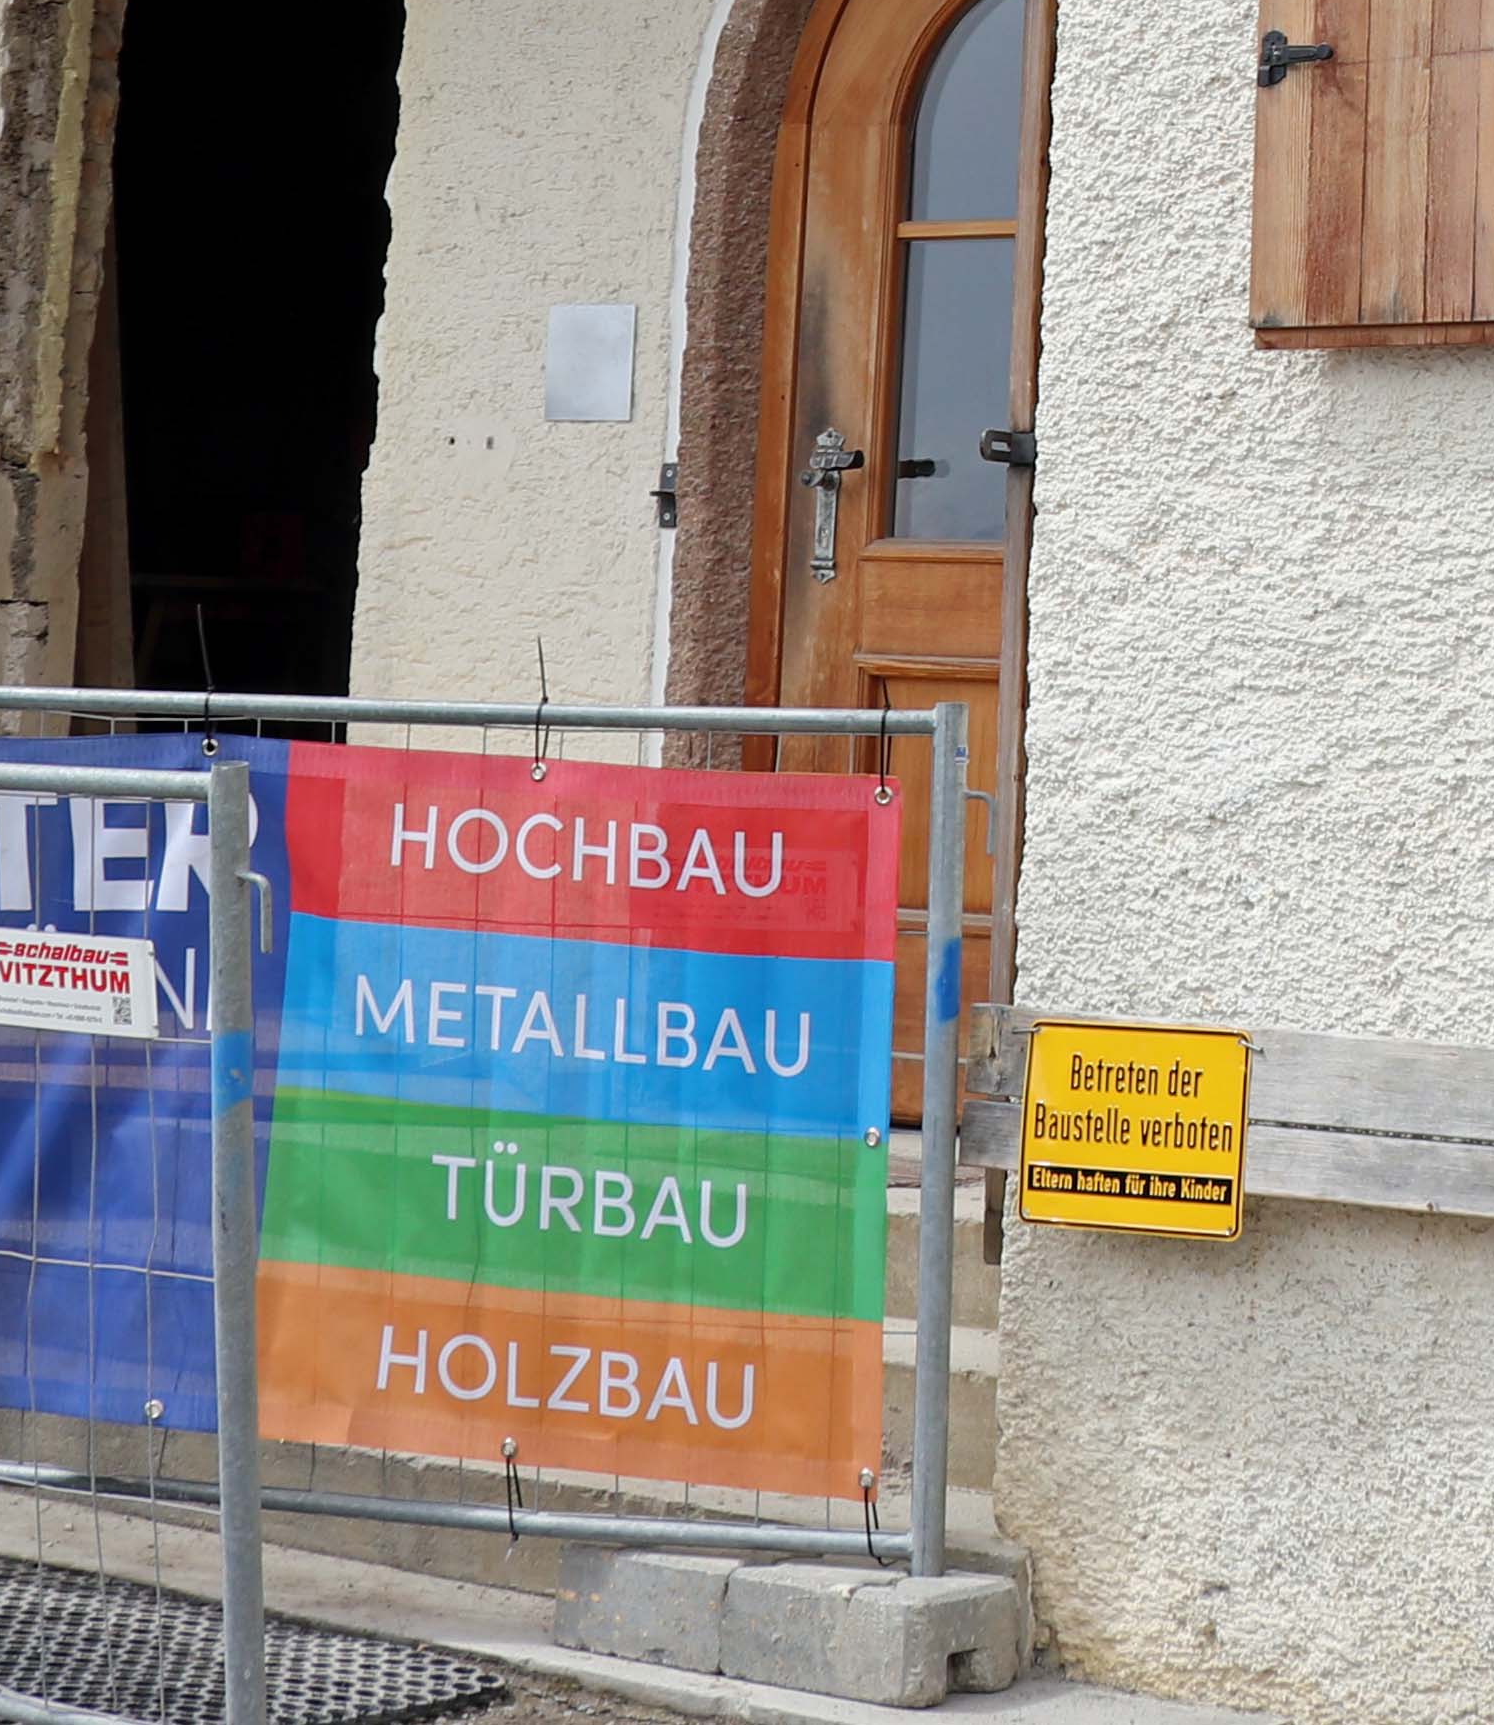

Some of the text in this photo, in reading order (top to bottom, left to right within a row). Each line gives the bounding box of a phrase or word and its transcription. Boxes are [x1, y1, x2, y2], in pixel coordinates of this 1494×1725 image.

[390, 802, 784, 897] HOCHBAU
[14, 942, 110, 964] schalbau
[354, 974, 811, 1078] METALLBAU
[1070, 1054, 1204, 1098] Betreten der
[1034, 1103, 1233, 1153] Baustelle verboten
[431, 1140, 748, 1249] TÜRBAU
[1032, 1167, 1227, 1202] Eltern haften für ihre Kinder
[376, 1324, 755, 1431] HOLZBAU
